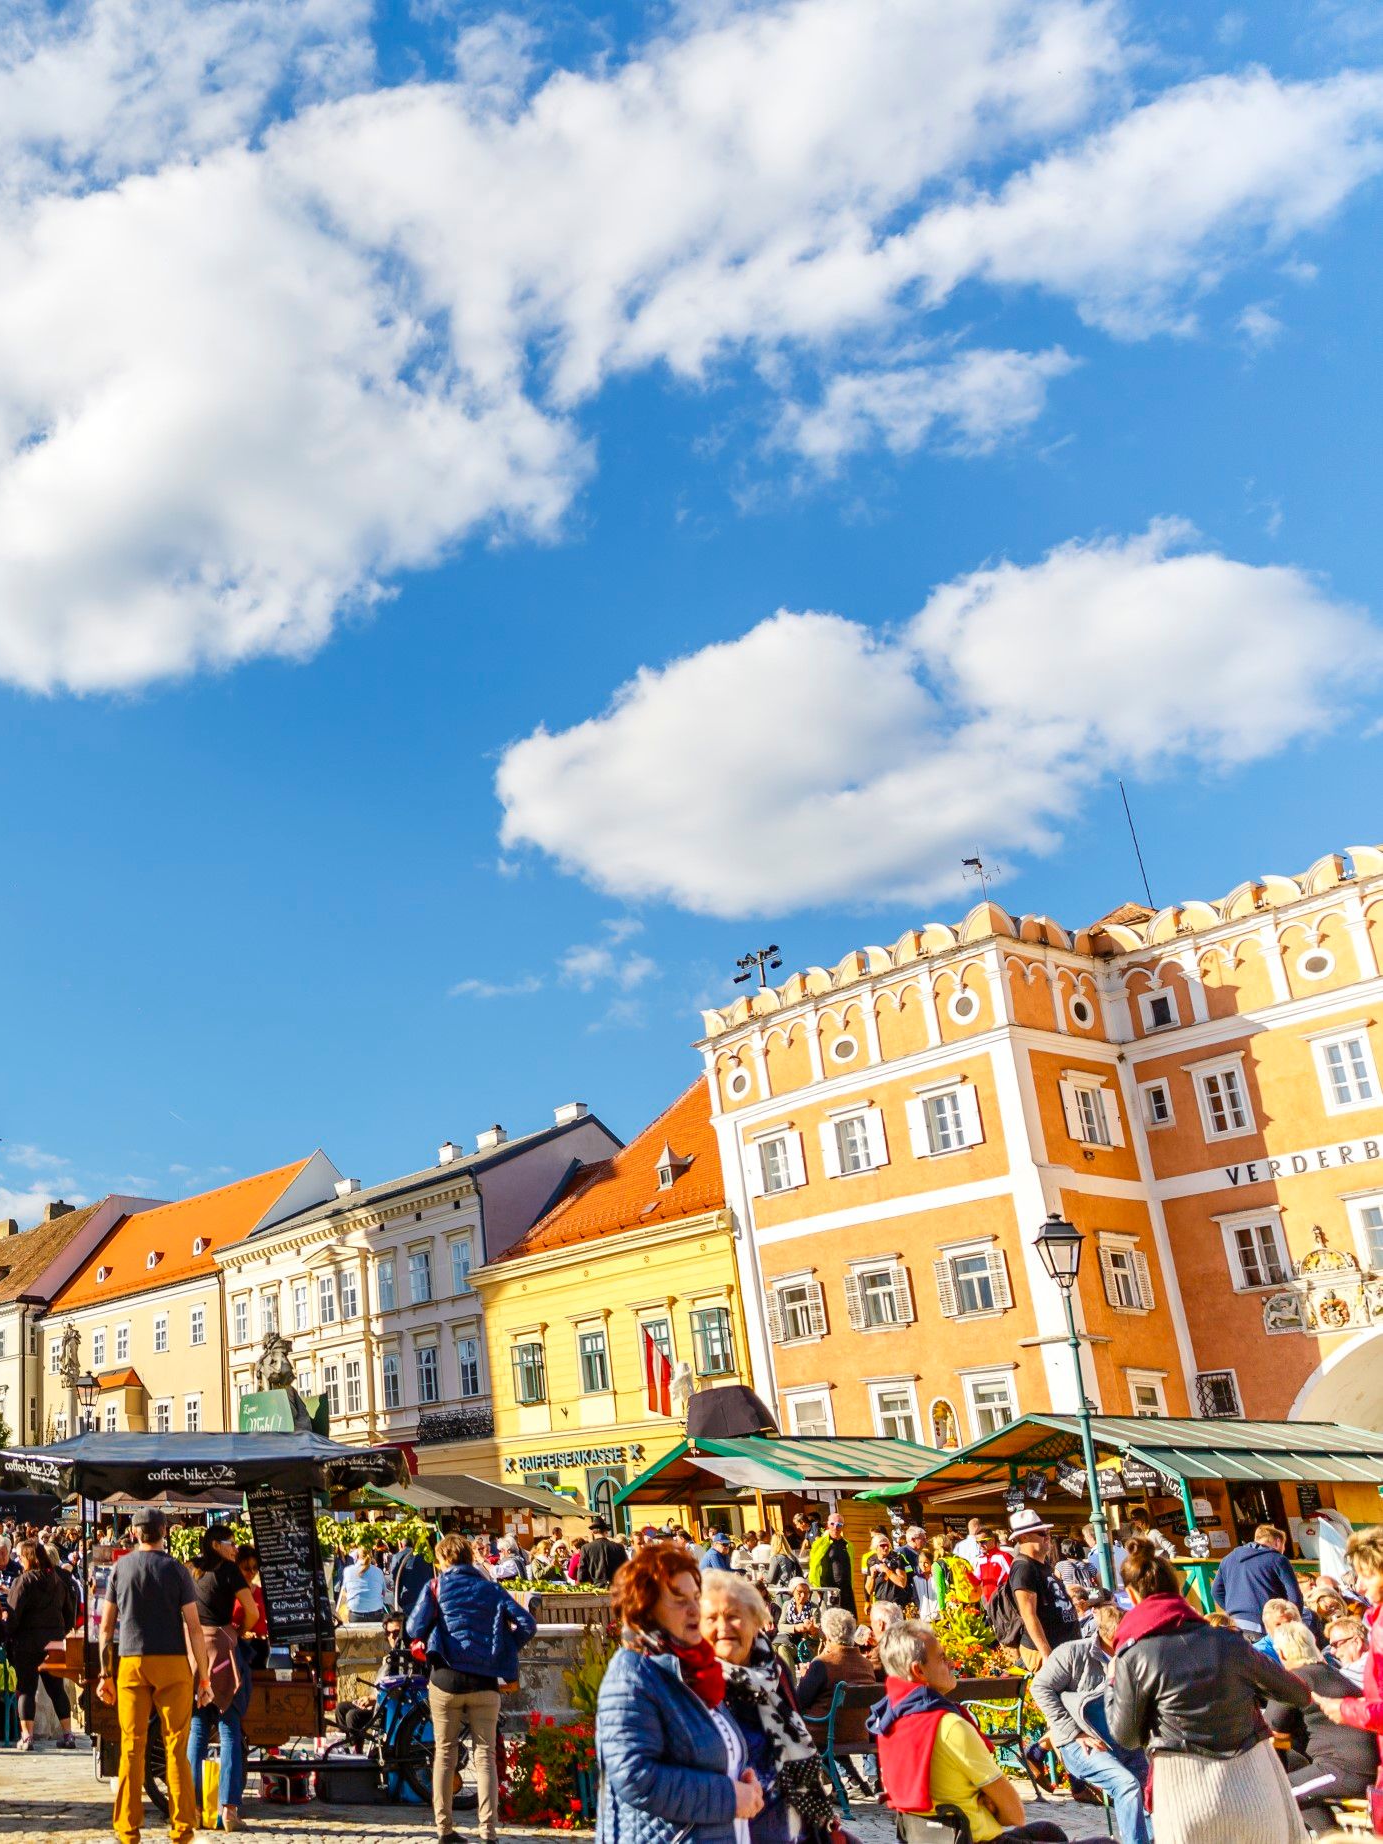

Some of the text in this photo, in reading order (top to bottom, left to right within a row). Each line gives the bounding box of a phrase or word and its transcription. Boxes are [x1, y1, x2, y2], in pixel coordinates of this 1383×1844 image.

[1225, 1141, 1381, 1186] VERDERB
[518, 1448, 623, 1470] RAIFFEISENKASSE
[148, 1467, 208, 1481] coffee-bike
